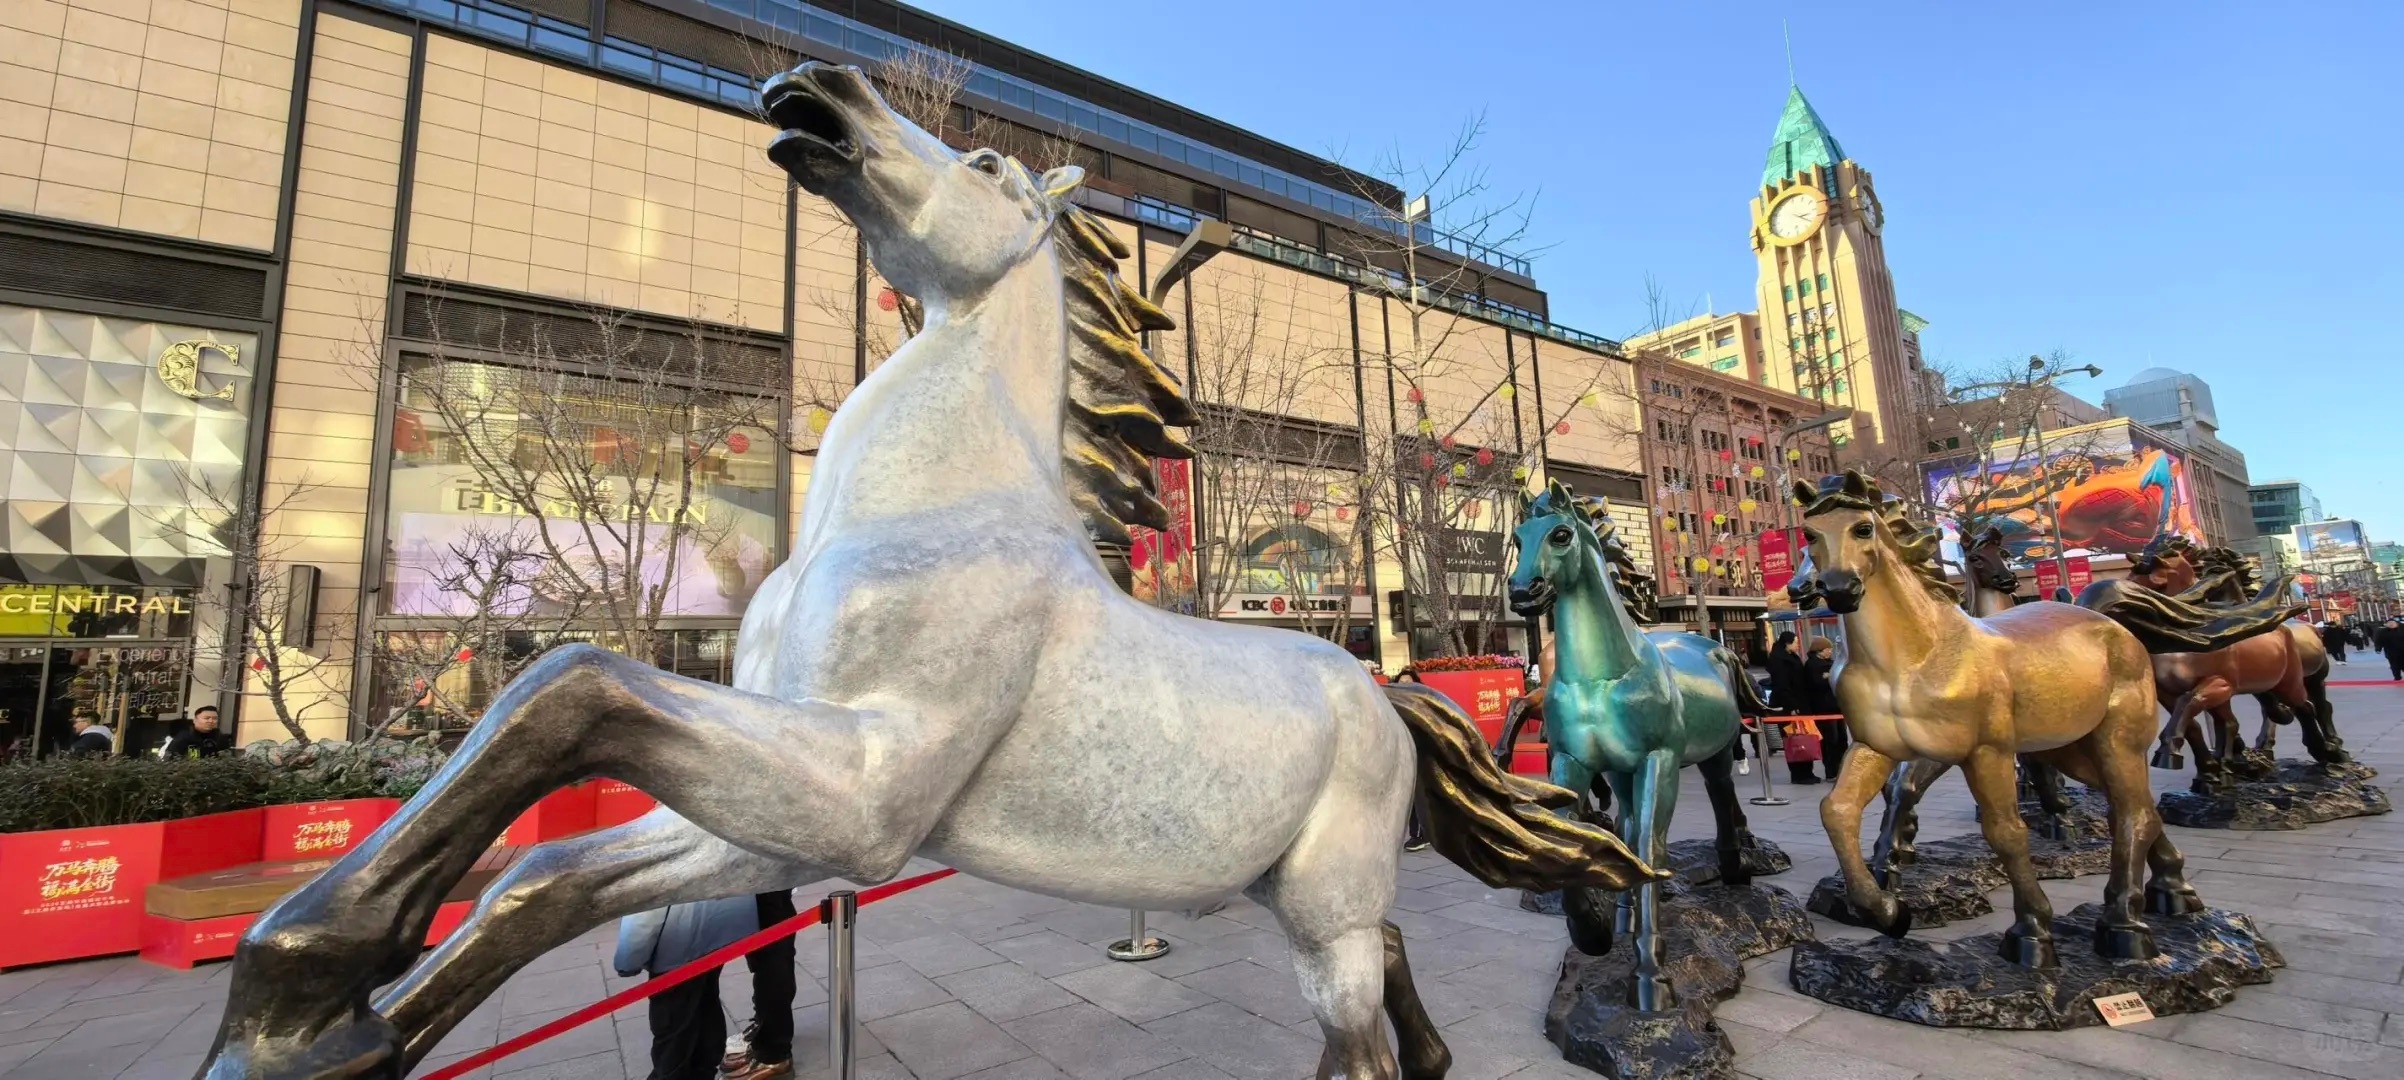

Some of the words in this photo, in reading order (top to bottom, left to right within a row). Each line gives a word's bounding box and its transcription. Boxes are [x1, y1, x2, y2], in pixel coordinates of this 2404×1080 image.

[158, 340, 240, 402] C
[1456, 536, 1485, 555] IWC
[1, 593, 191, 615] CENTRAL
[1242, 599, 1268, 612] ICBC
[39, 856, 122, 881] 万马奔腾
